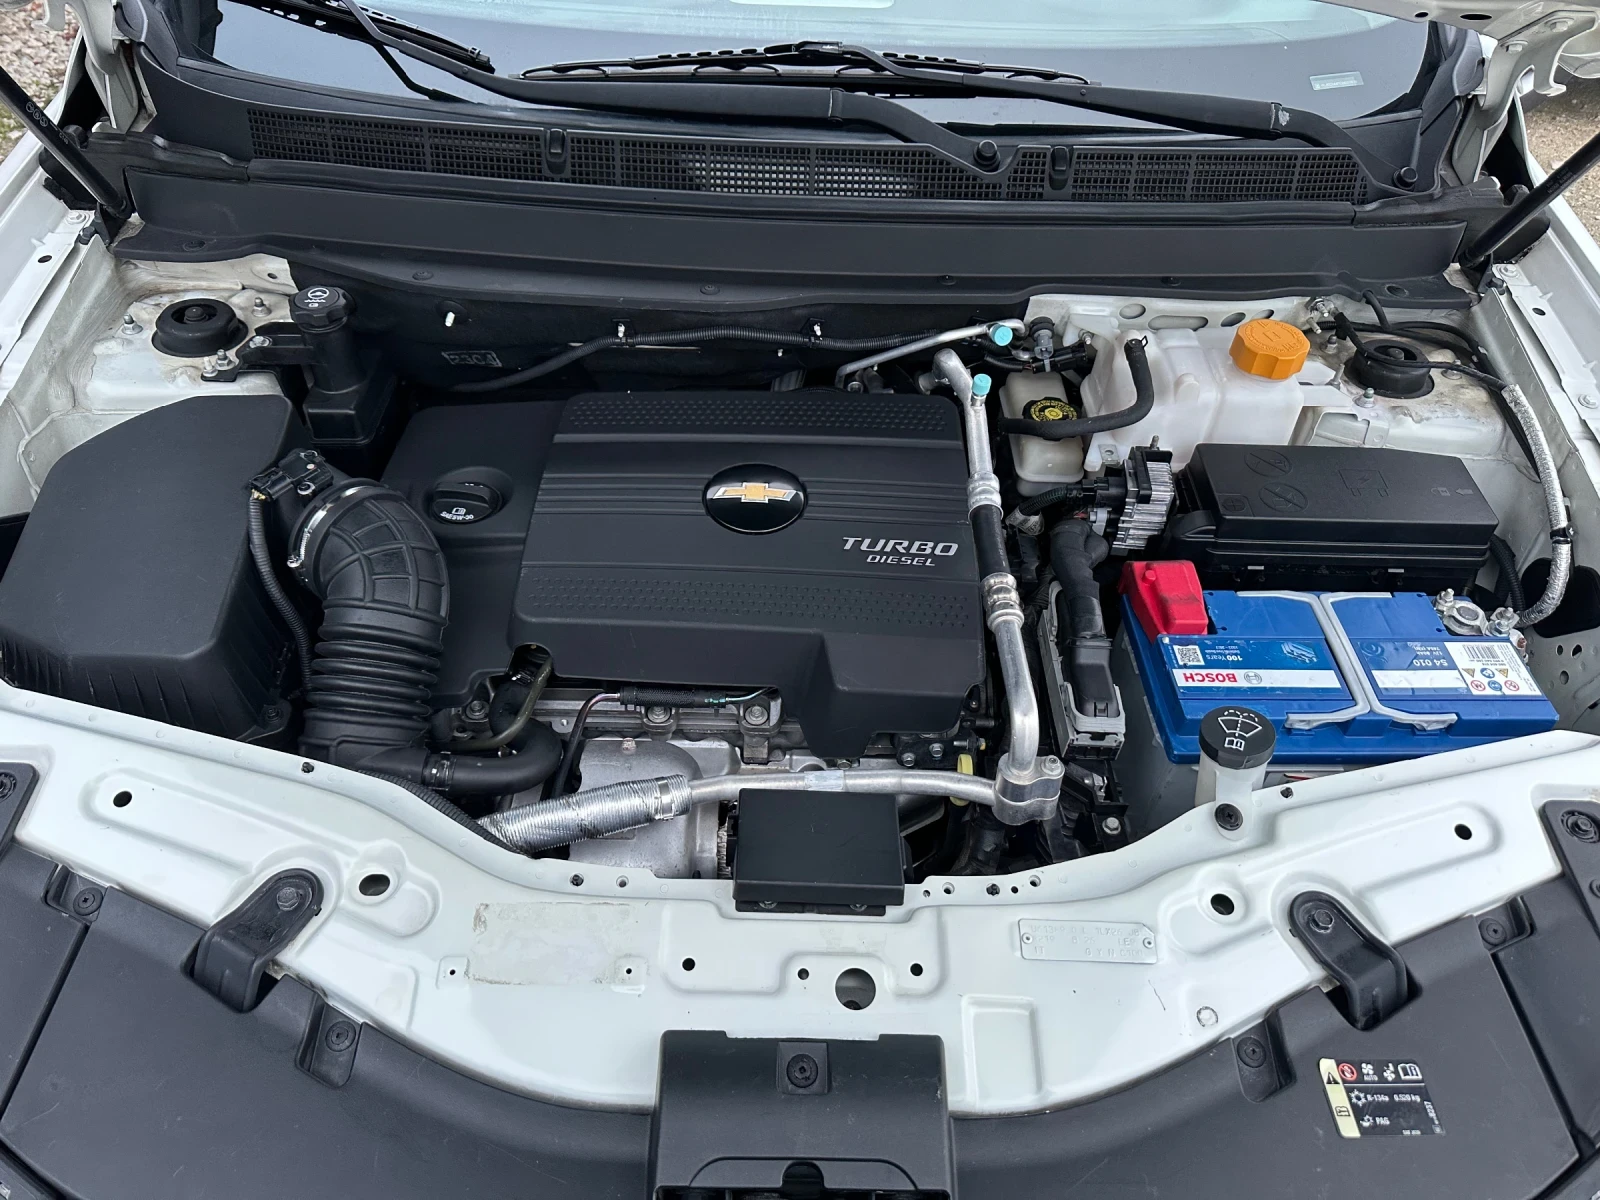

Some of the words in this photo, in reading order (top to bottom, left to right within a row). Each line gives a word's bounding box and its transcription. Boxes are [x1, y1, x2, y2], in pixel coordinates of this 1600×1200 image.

[843, 537, 959, 556] TURBO
[866, 554, 935, 567] DIESEL
[1412, 658, 1432, 667] 010
[1433, 658, 1449, 667] S4
[1182, 672, 1238, 683] BOSCH
